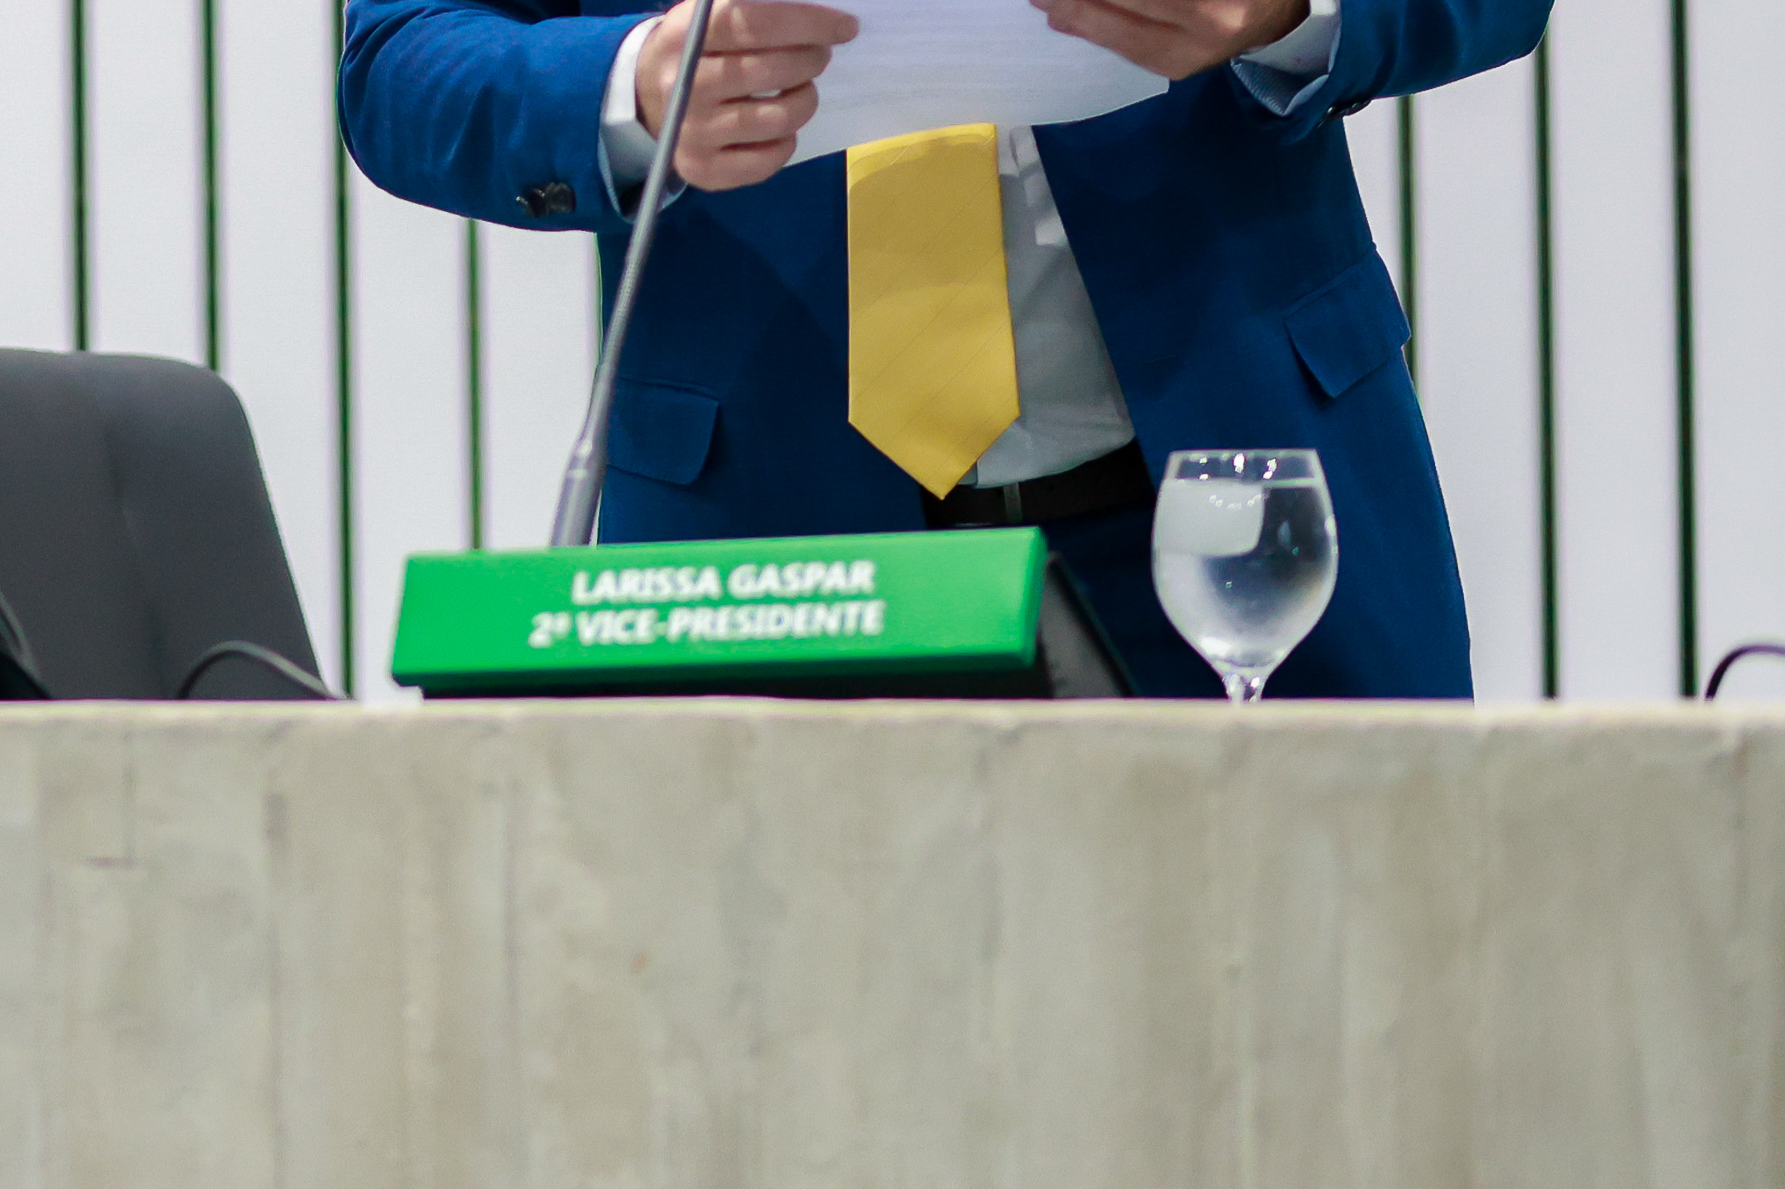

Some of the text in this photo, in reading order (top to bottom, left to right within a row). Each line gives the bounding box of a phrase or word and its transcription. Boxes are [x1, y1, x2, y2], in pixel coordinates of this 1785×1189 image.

[571, 559, 877, 605] LARISSA GASPAR
[575, 600, 885, 646] VICE-PRESIDENTE
